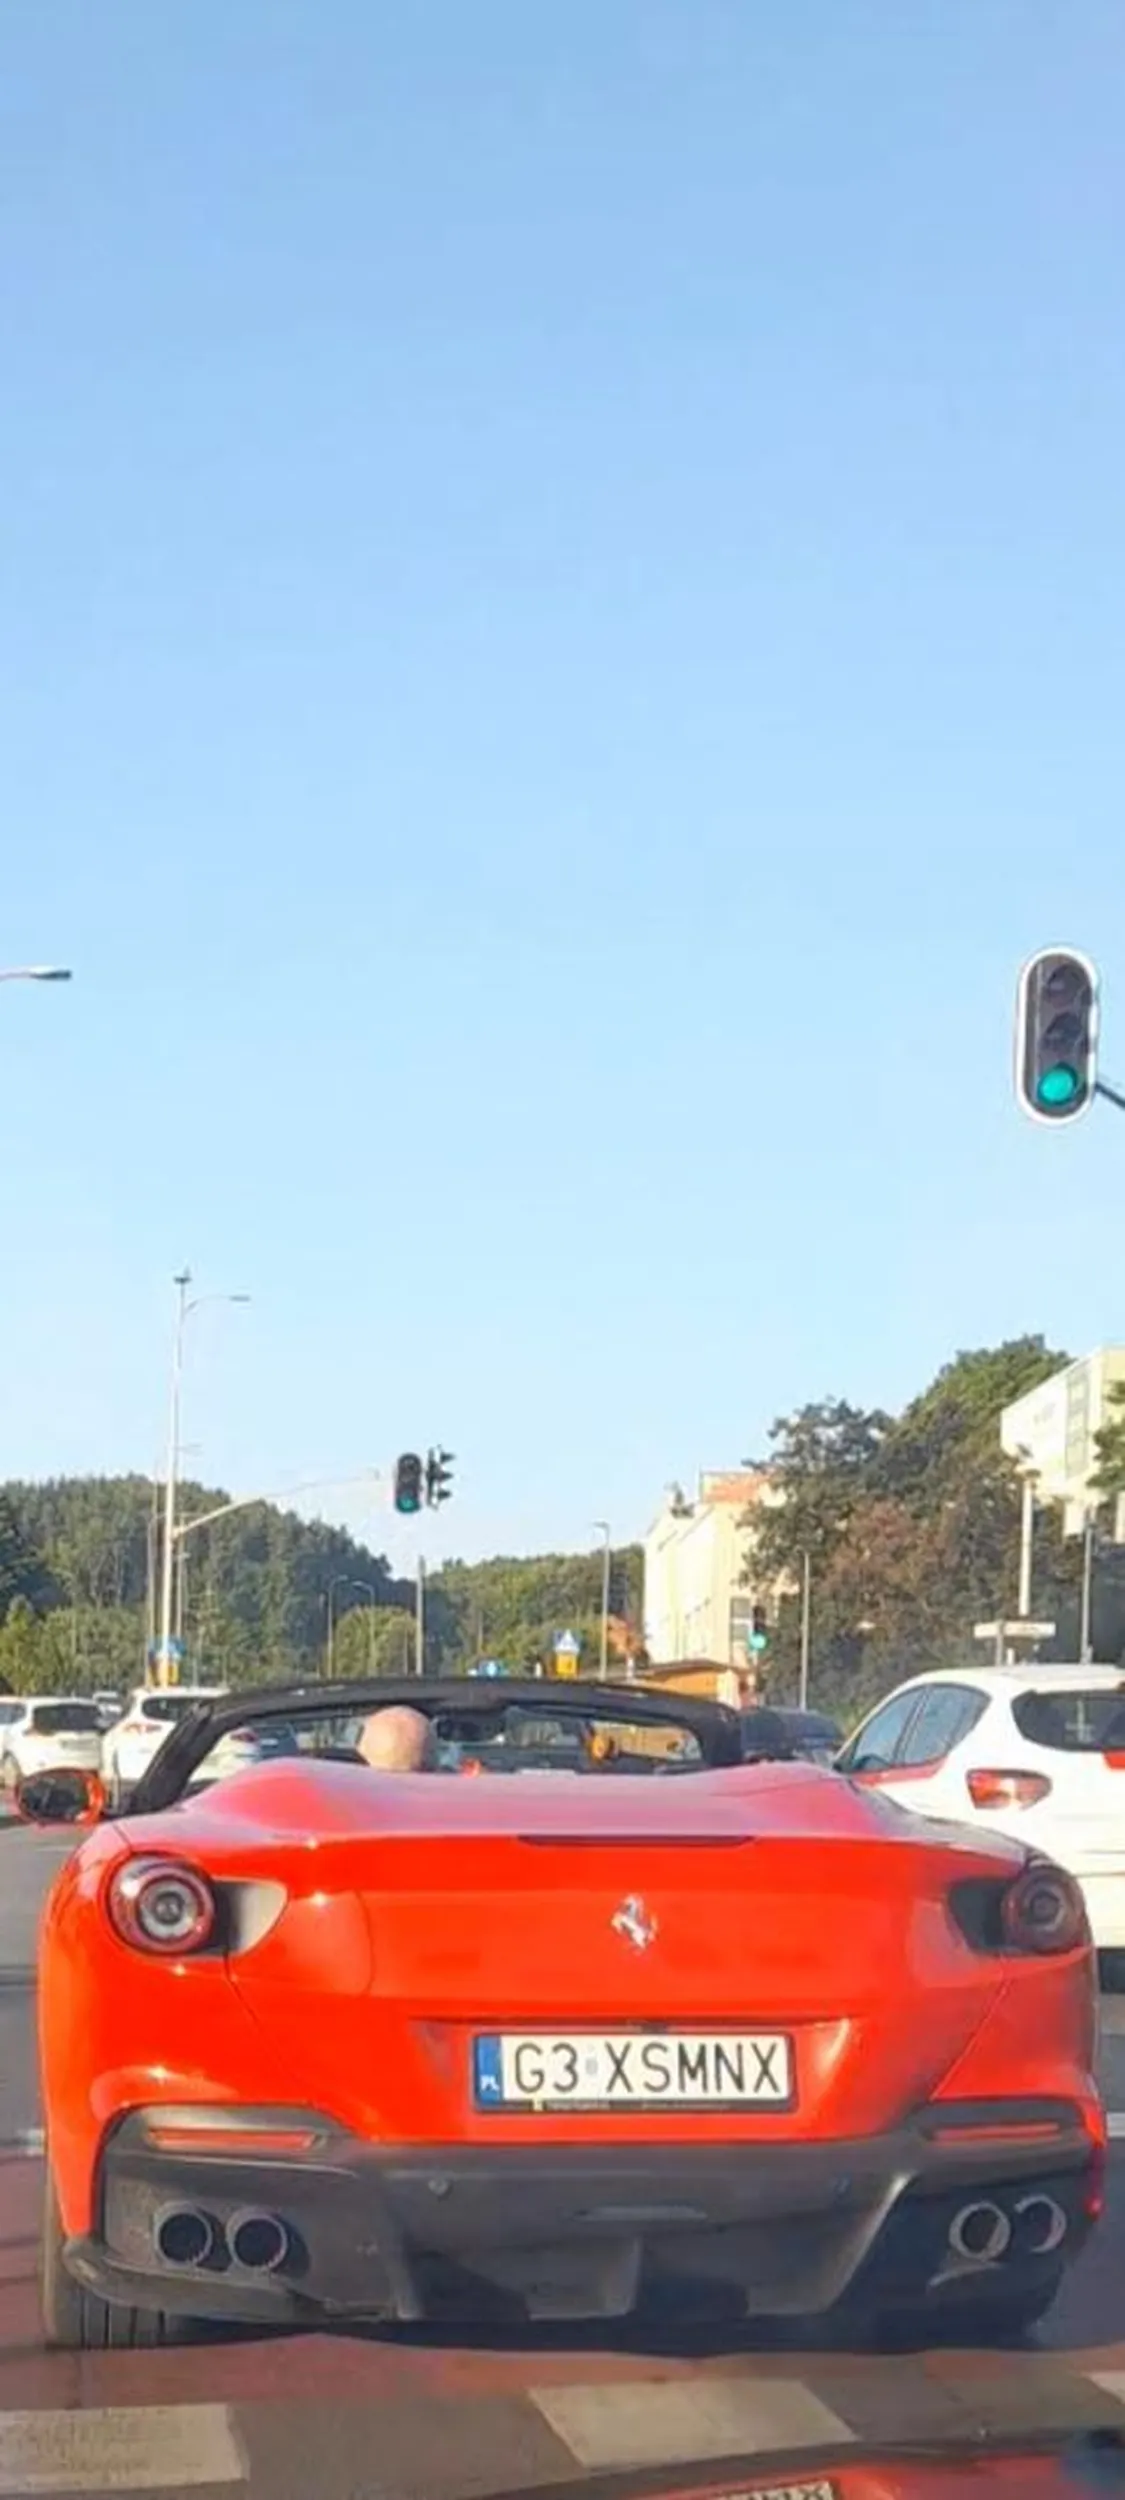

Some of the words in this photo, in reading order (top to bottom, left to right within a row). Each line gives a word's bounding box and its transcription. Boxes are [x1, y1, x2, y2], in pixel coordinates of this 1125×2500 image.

[481, 2075, 499, 2090] PL
[515, 2042, 578, 2093] G3
[604, 2042, 780, 2093] XSMNX
